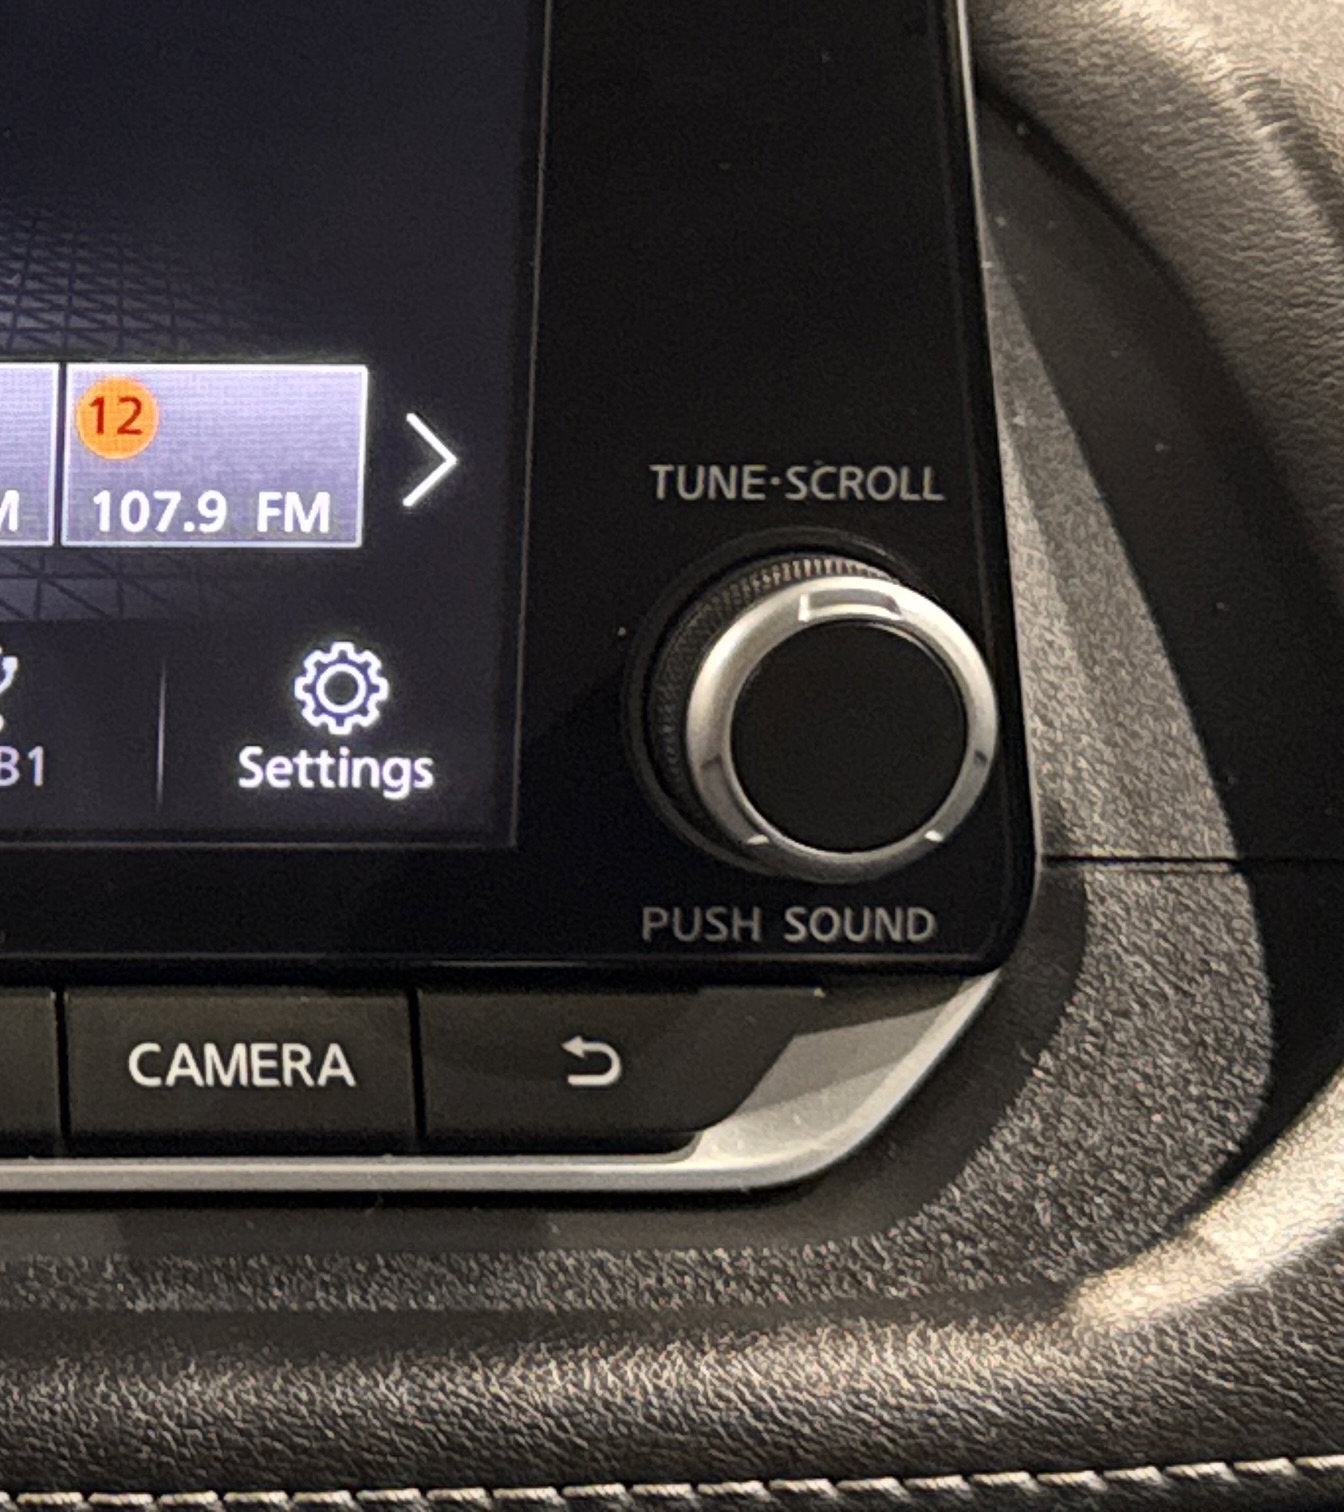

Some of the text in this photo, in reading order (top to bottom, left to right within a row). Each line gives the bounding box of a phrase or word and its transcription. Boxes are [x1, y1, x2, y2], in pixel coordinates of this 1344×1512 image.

[88, 394, 143, 436] 12
[93, 490, 330, 534] 107.9 FM
[238, 745, 434, 800] Settings
[641, 906, 938, 944] PUSH SOUND
[128, 1041, 357, 1088] CAMERA
